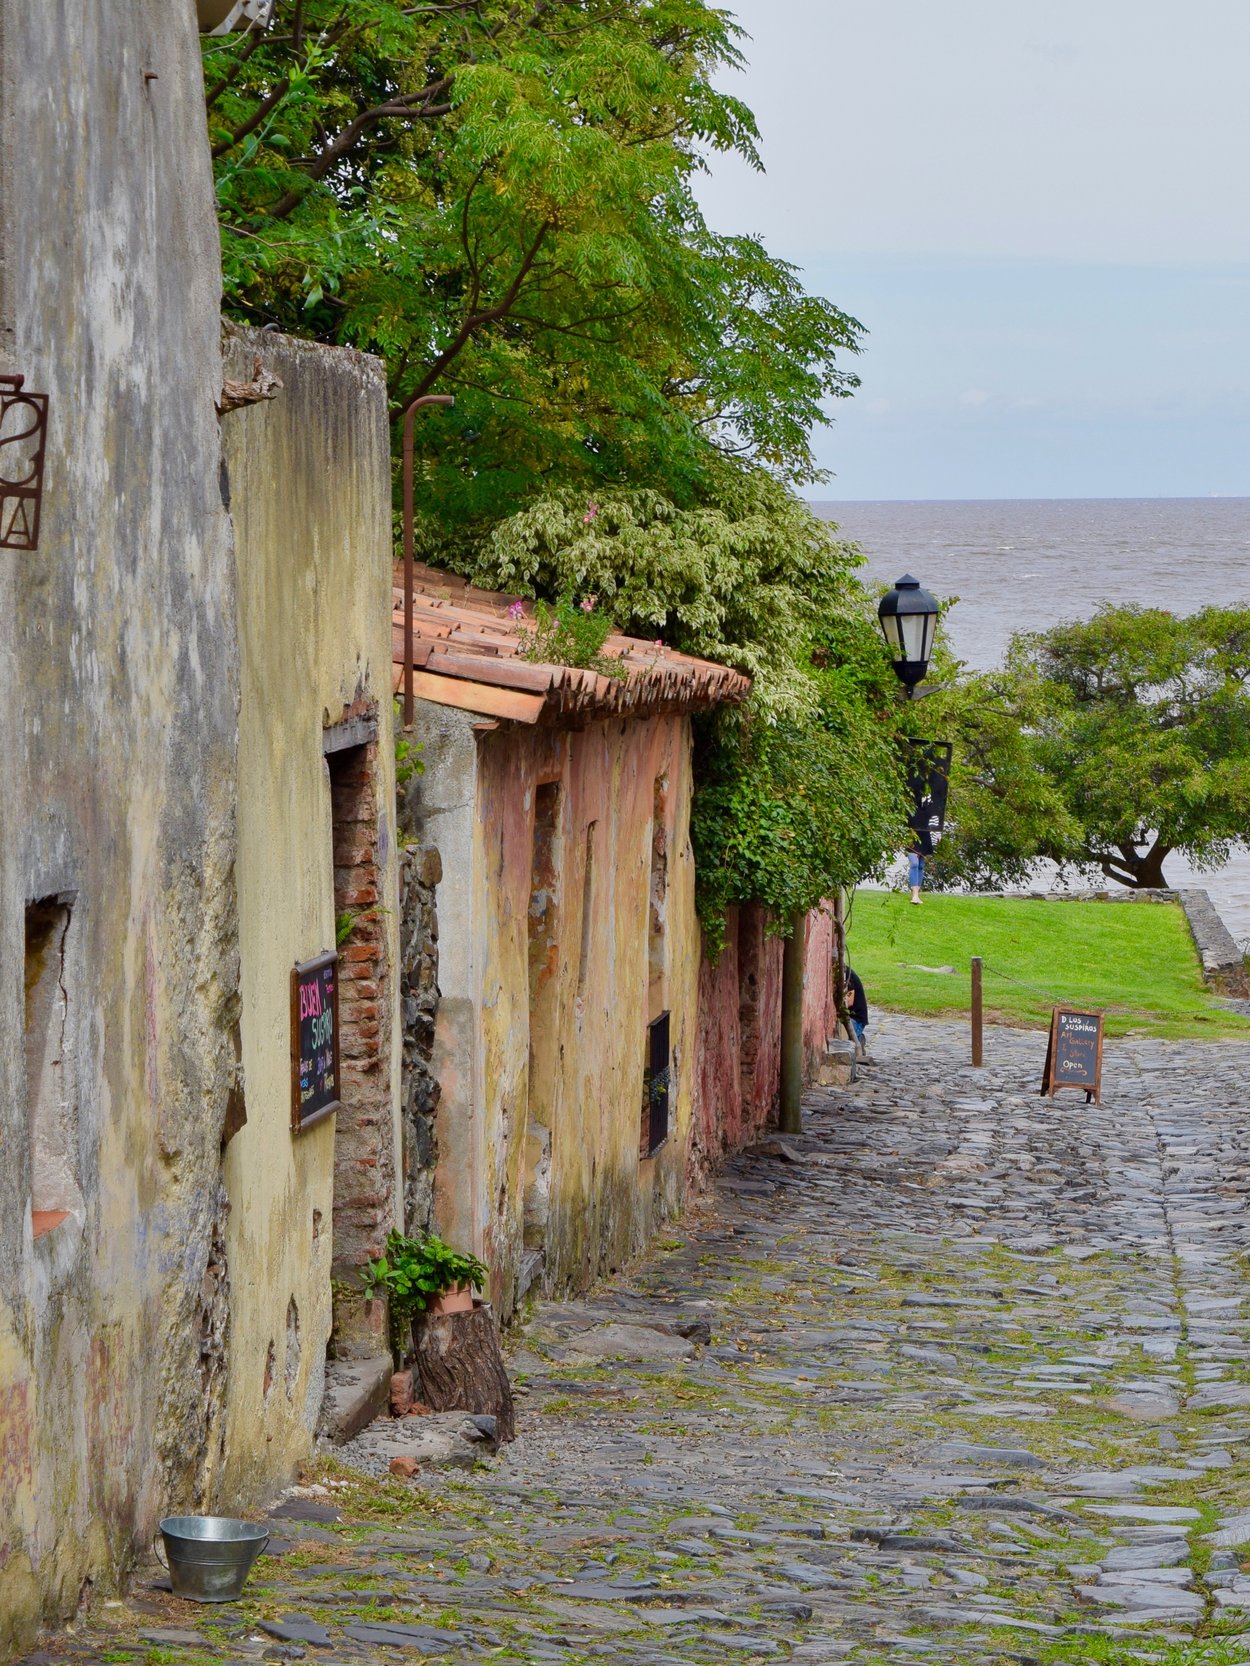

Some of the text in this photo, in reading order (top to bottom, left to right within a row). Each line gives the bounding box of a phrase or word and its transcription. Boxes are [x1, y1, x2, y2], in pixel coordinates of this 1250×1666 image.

[299, 979, 323, 1022] BUEN
[1069, 1017, 1082, 1025] LOS
[1062, 1060, 1083, 1070] Open
